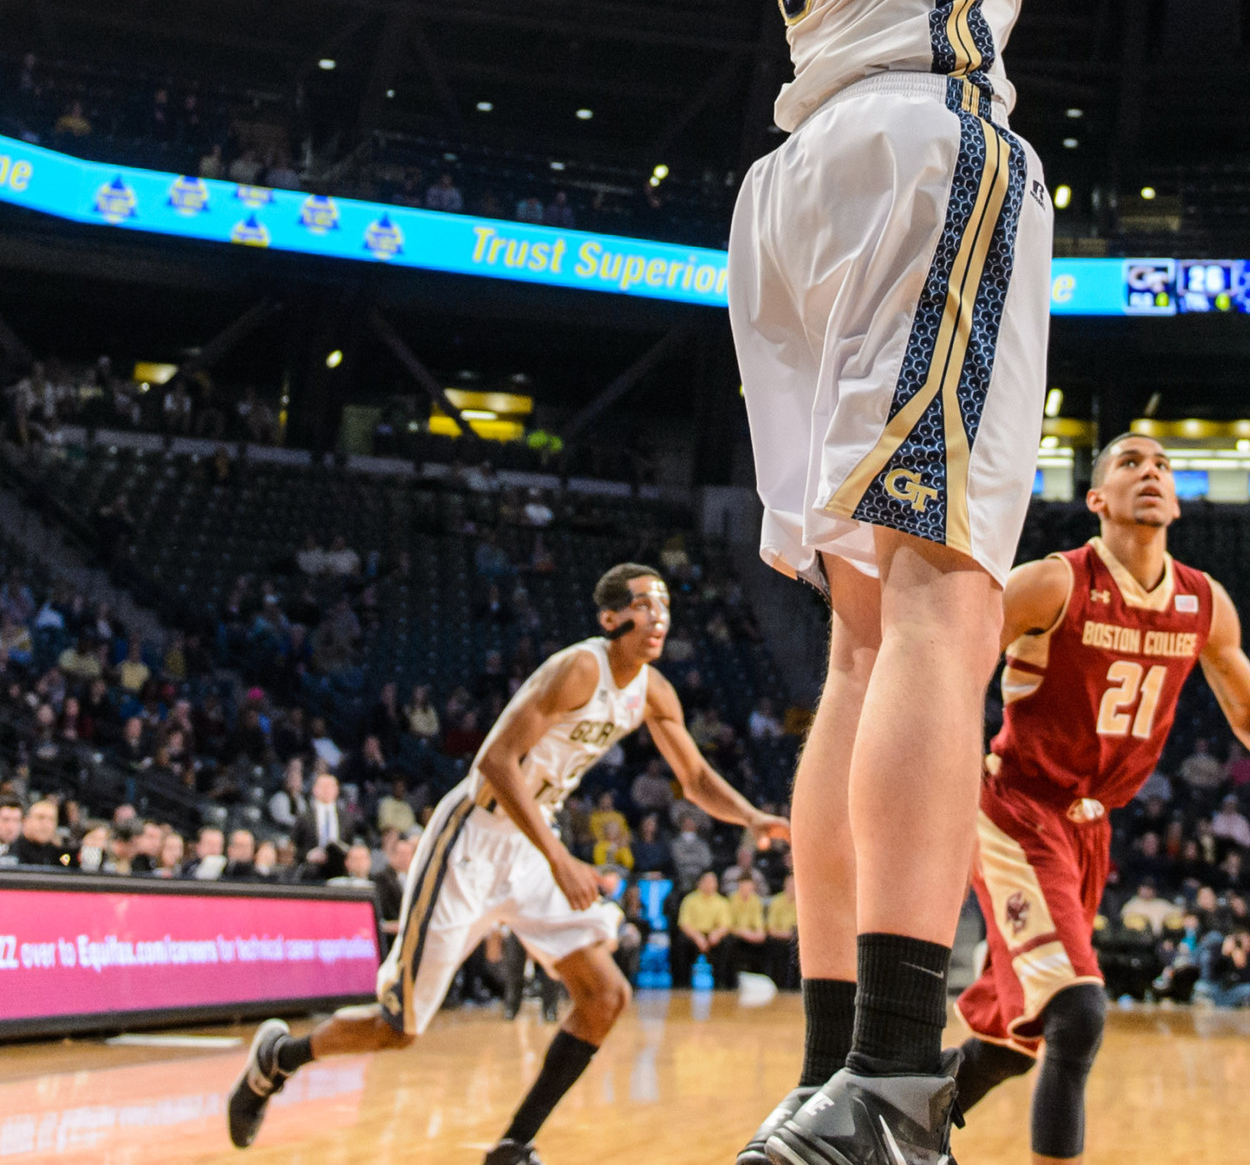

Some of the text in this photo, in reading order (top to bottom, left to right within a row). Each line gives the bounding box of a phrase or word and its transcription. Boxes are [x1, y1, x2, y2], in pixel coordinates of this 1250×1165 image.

[473, 226, 567, 274] Trust
[1081, 620, 1198, 658] BOSTON COLLEGE
[1095, 660, 1168, 740] 21
[20, 942, 56, 969] over
[58, 937, 77, 968] to
